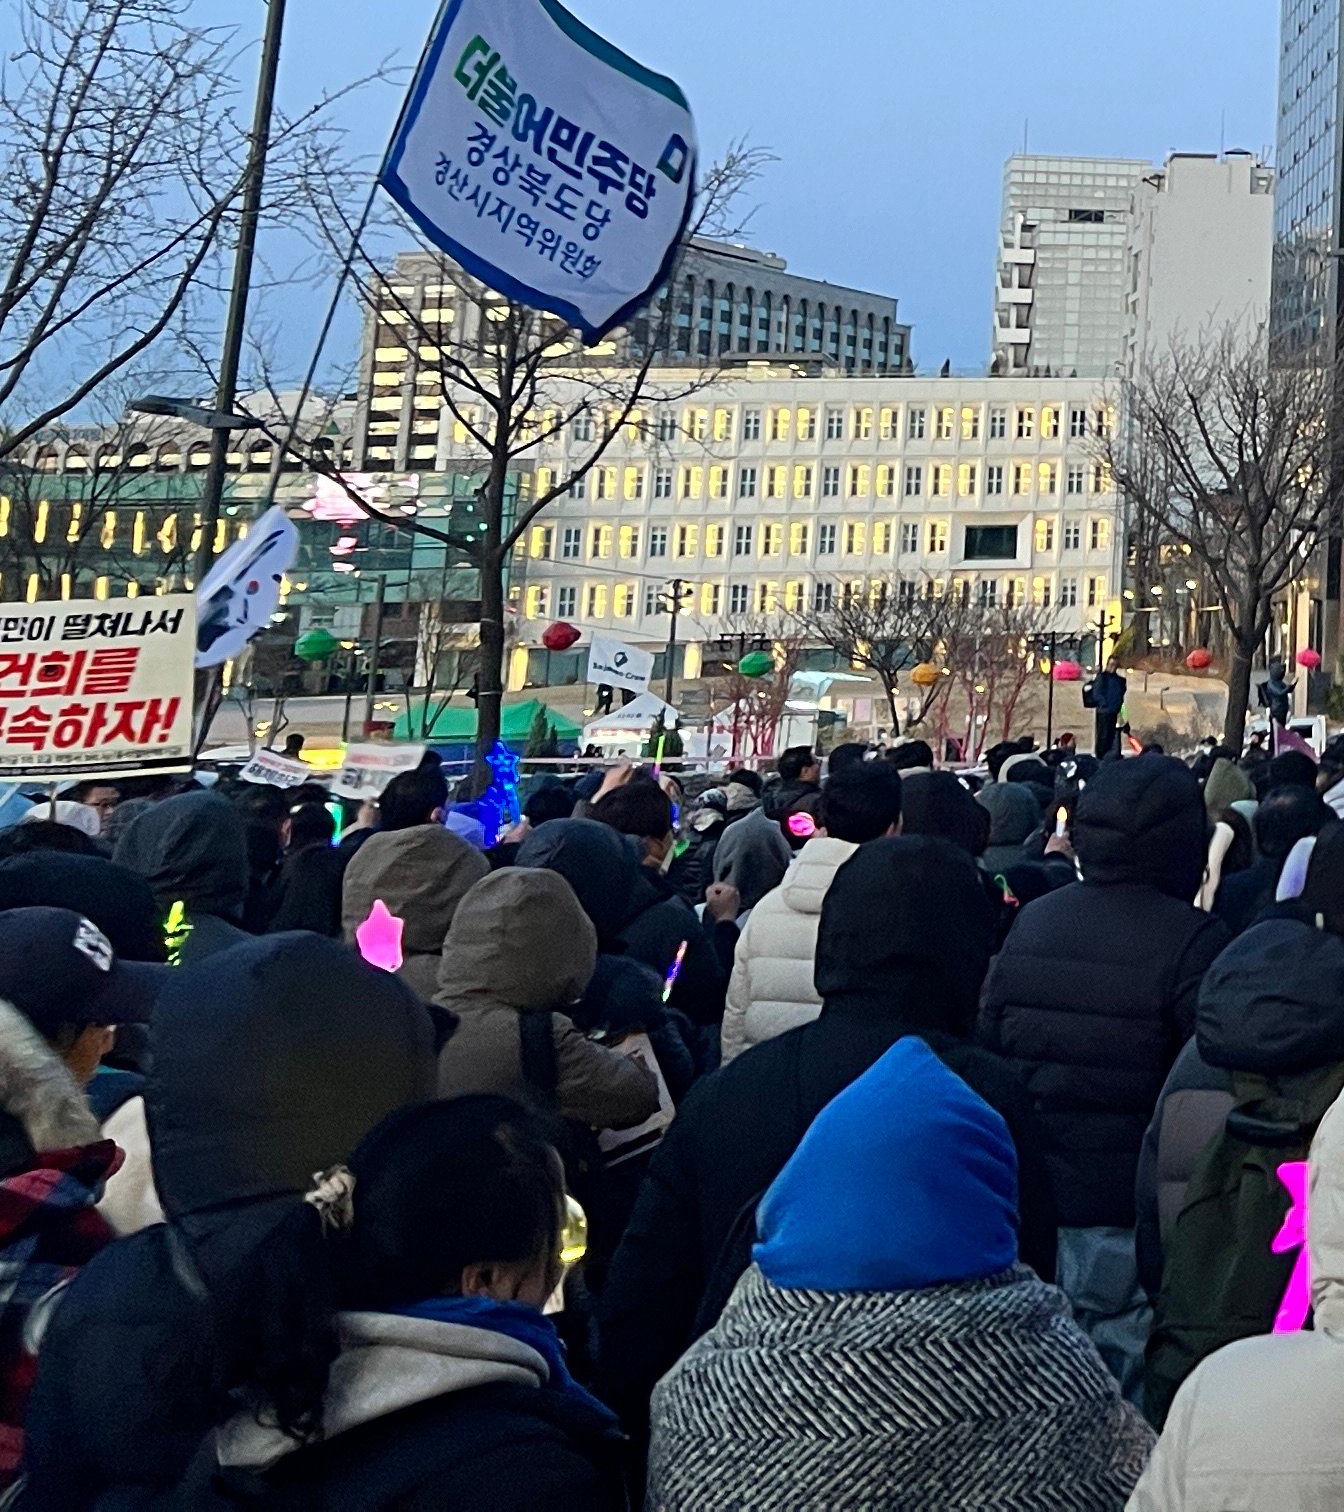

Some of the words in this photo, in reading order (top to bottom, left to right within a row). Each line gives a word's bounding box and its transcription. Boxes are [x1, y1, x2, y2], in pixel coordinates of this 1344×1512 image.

[454, 35, 656, 219] 더불어민주당
[434, 151, 602, 280] 경산시지역위원회
[466, 122, 611, 242] 경상북도당
[0, 615, 56, 642] 민이
[60, 608, 184, 641] 떨쳐나서
[0, 646, 141, 698] 건희를
[0, 696, 181, 752] 속하자!
